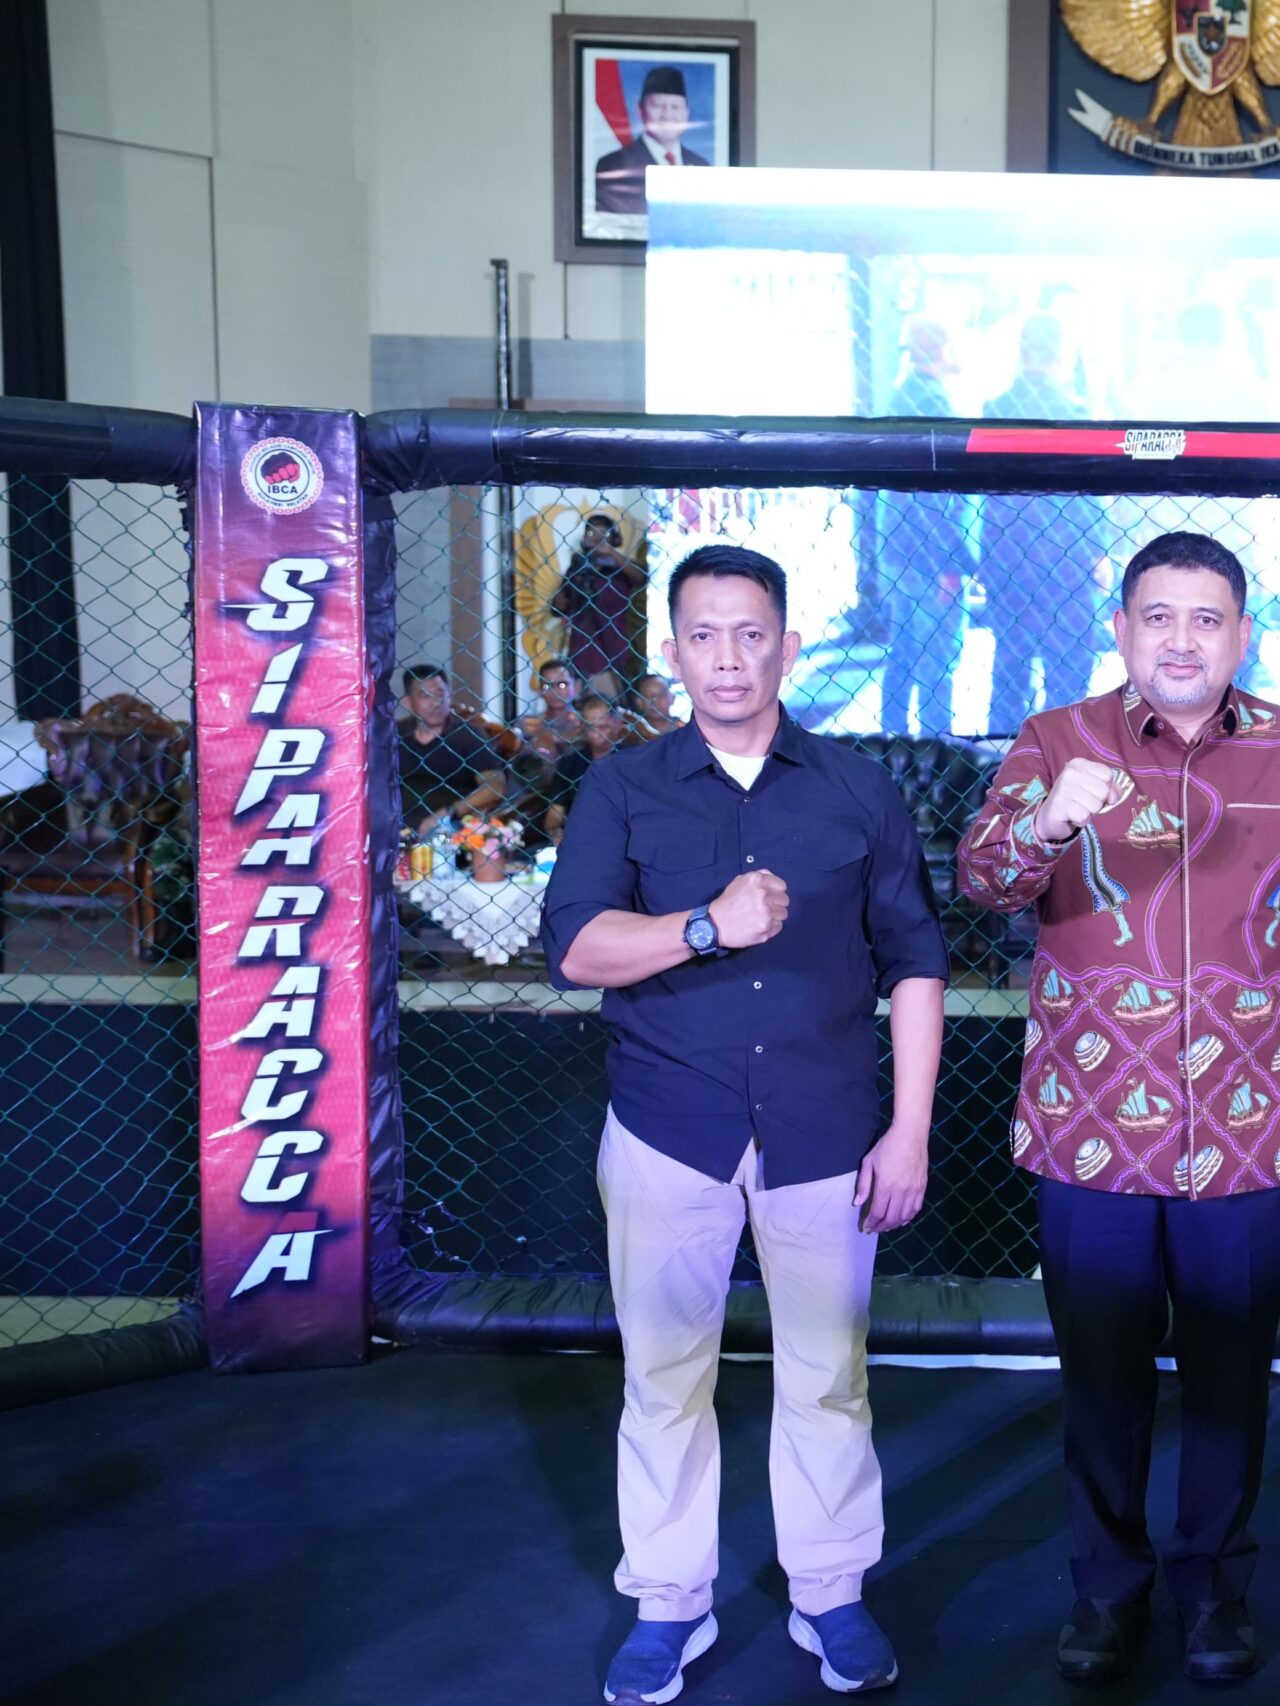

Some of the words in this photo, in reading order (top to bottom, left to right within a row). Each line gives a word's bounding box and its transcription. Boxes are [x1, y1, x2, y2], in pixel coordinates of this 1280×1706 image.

[1201, 149, 1256, 166] TUNGGAL
[1261, 143, 1280, 159] IKA
[267, 485, 298, 494] IBCA
[222, 557, 335, 1299] SIPARACCA
